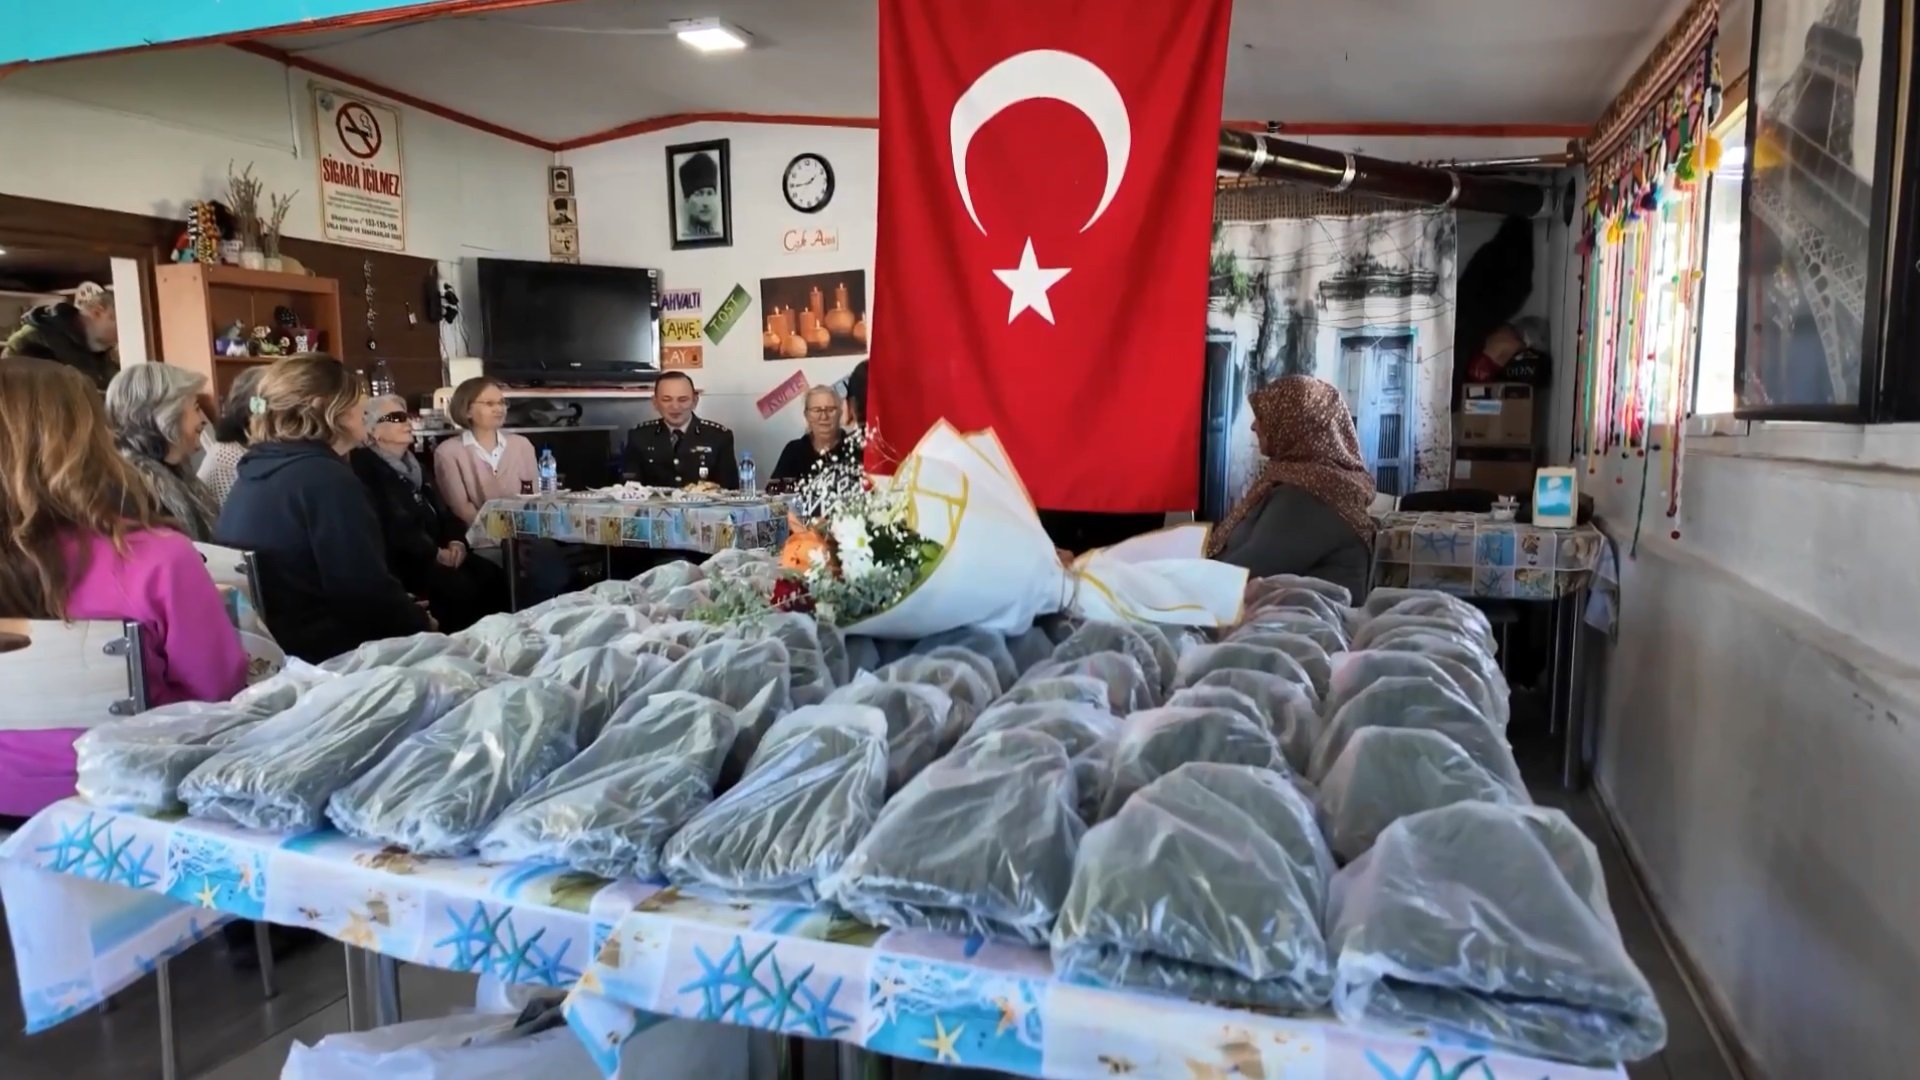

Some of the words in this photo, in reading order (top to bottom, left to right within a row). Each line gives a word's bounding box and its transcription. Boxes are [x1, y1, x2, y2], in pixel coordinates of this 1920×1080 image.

[322, 153, 361, 189] SİGARA
[361, 161, 401, 198] İÇİLMEZ
[709, 294, 739, 332] TOST
